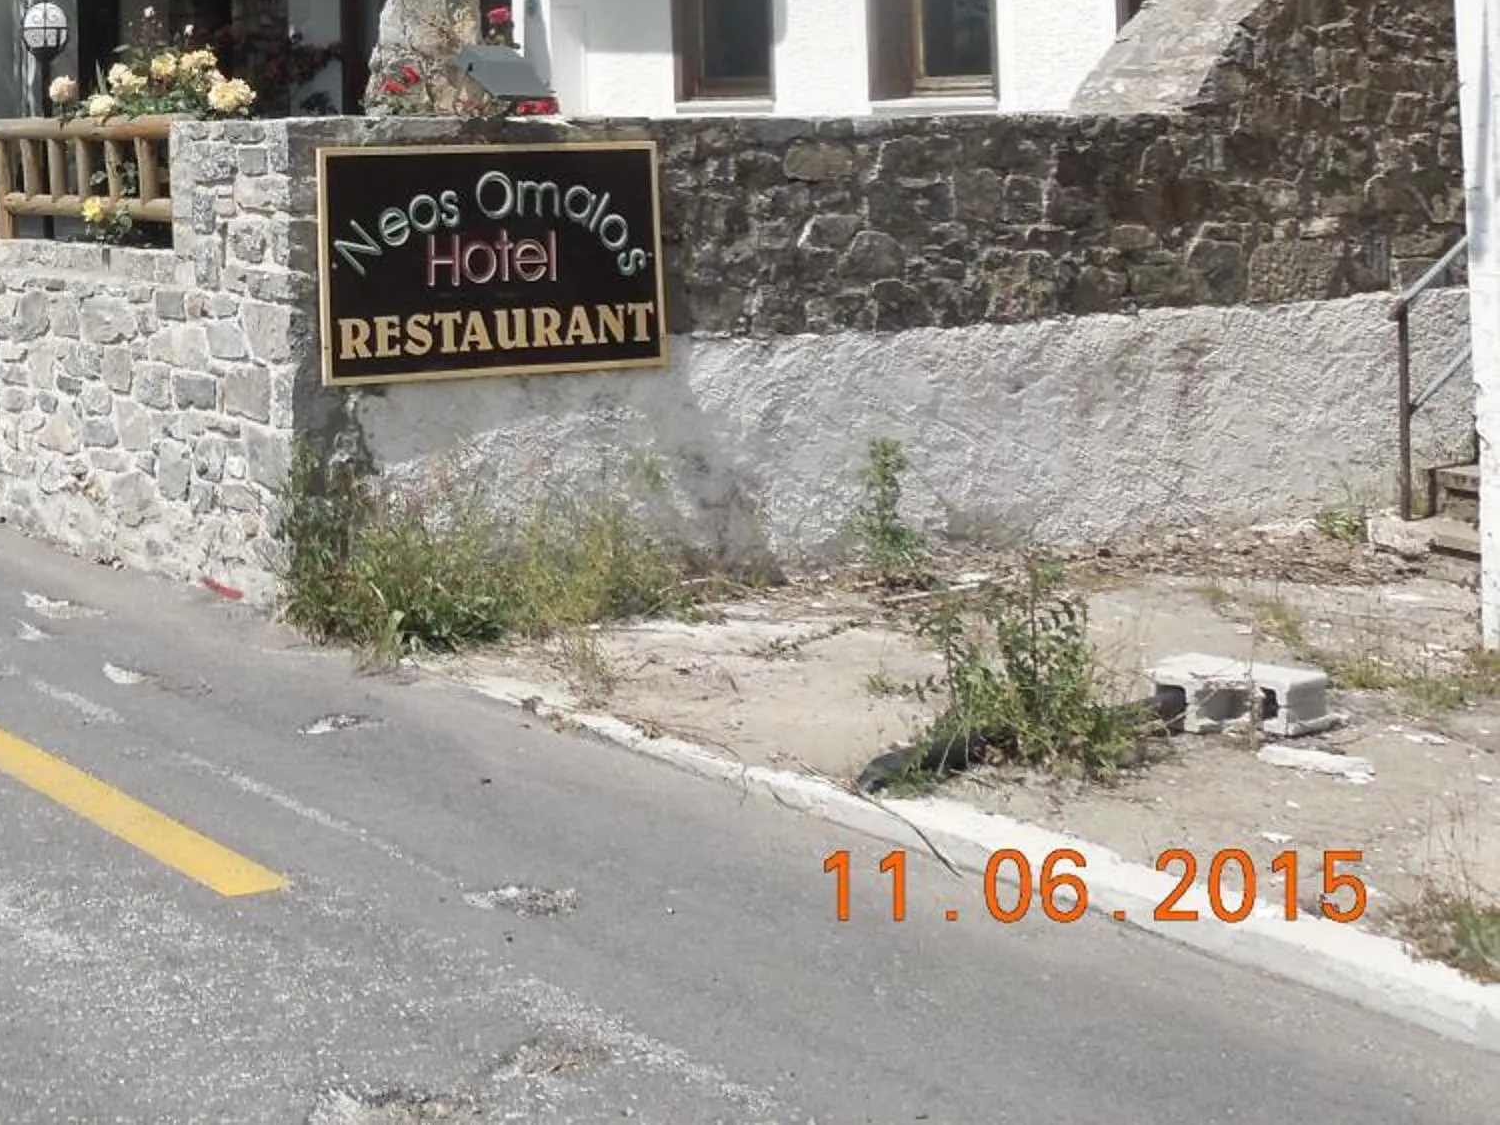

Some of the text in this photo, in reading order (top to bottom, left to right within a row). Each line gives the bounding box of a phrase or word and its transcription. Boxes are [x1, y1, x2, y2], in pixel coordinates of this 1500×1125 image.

[332, 170, 647, 276] Neos Omalos
[427, 228, 558, 287] Hotel
[337, 302, 654, 360] RESTAURANT
